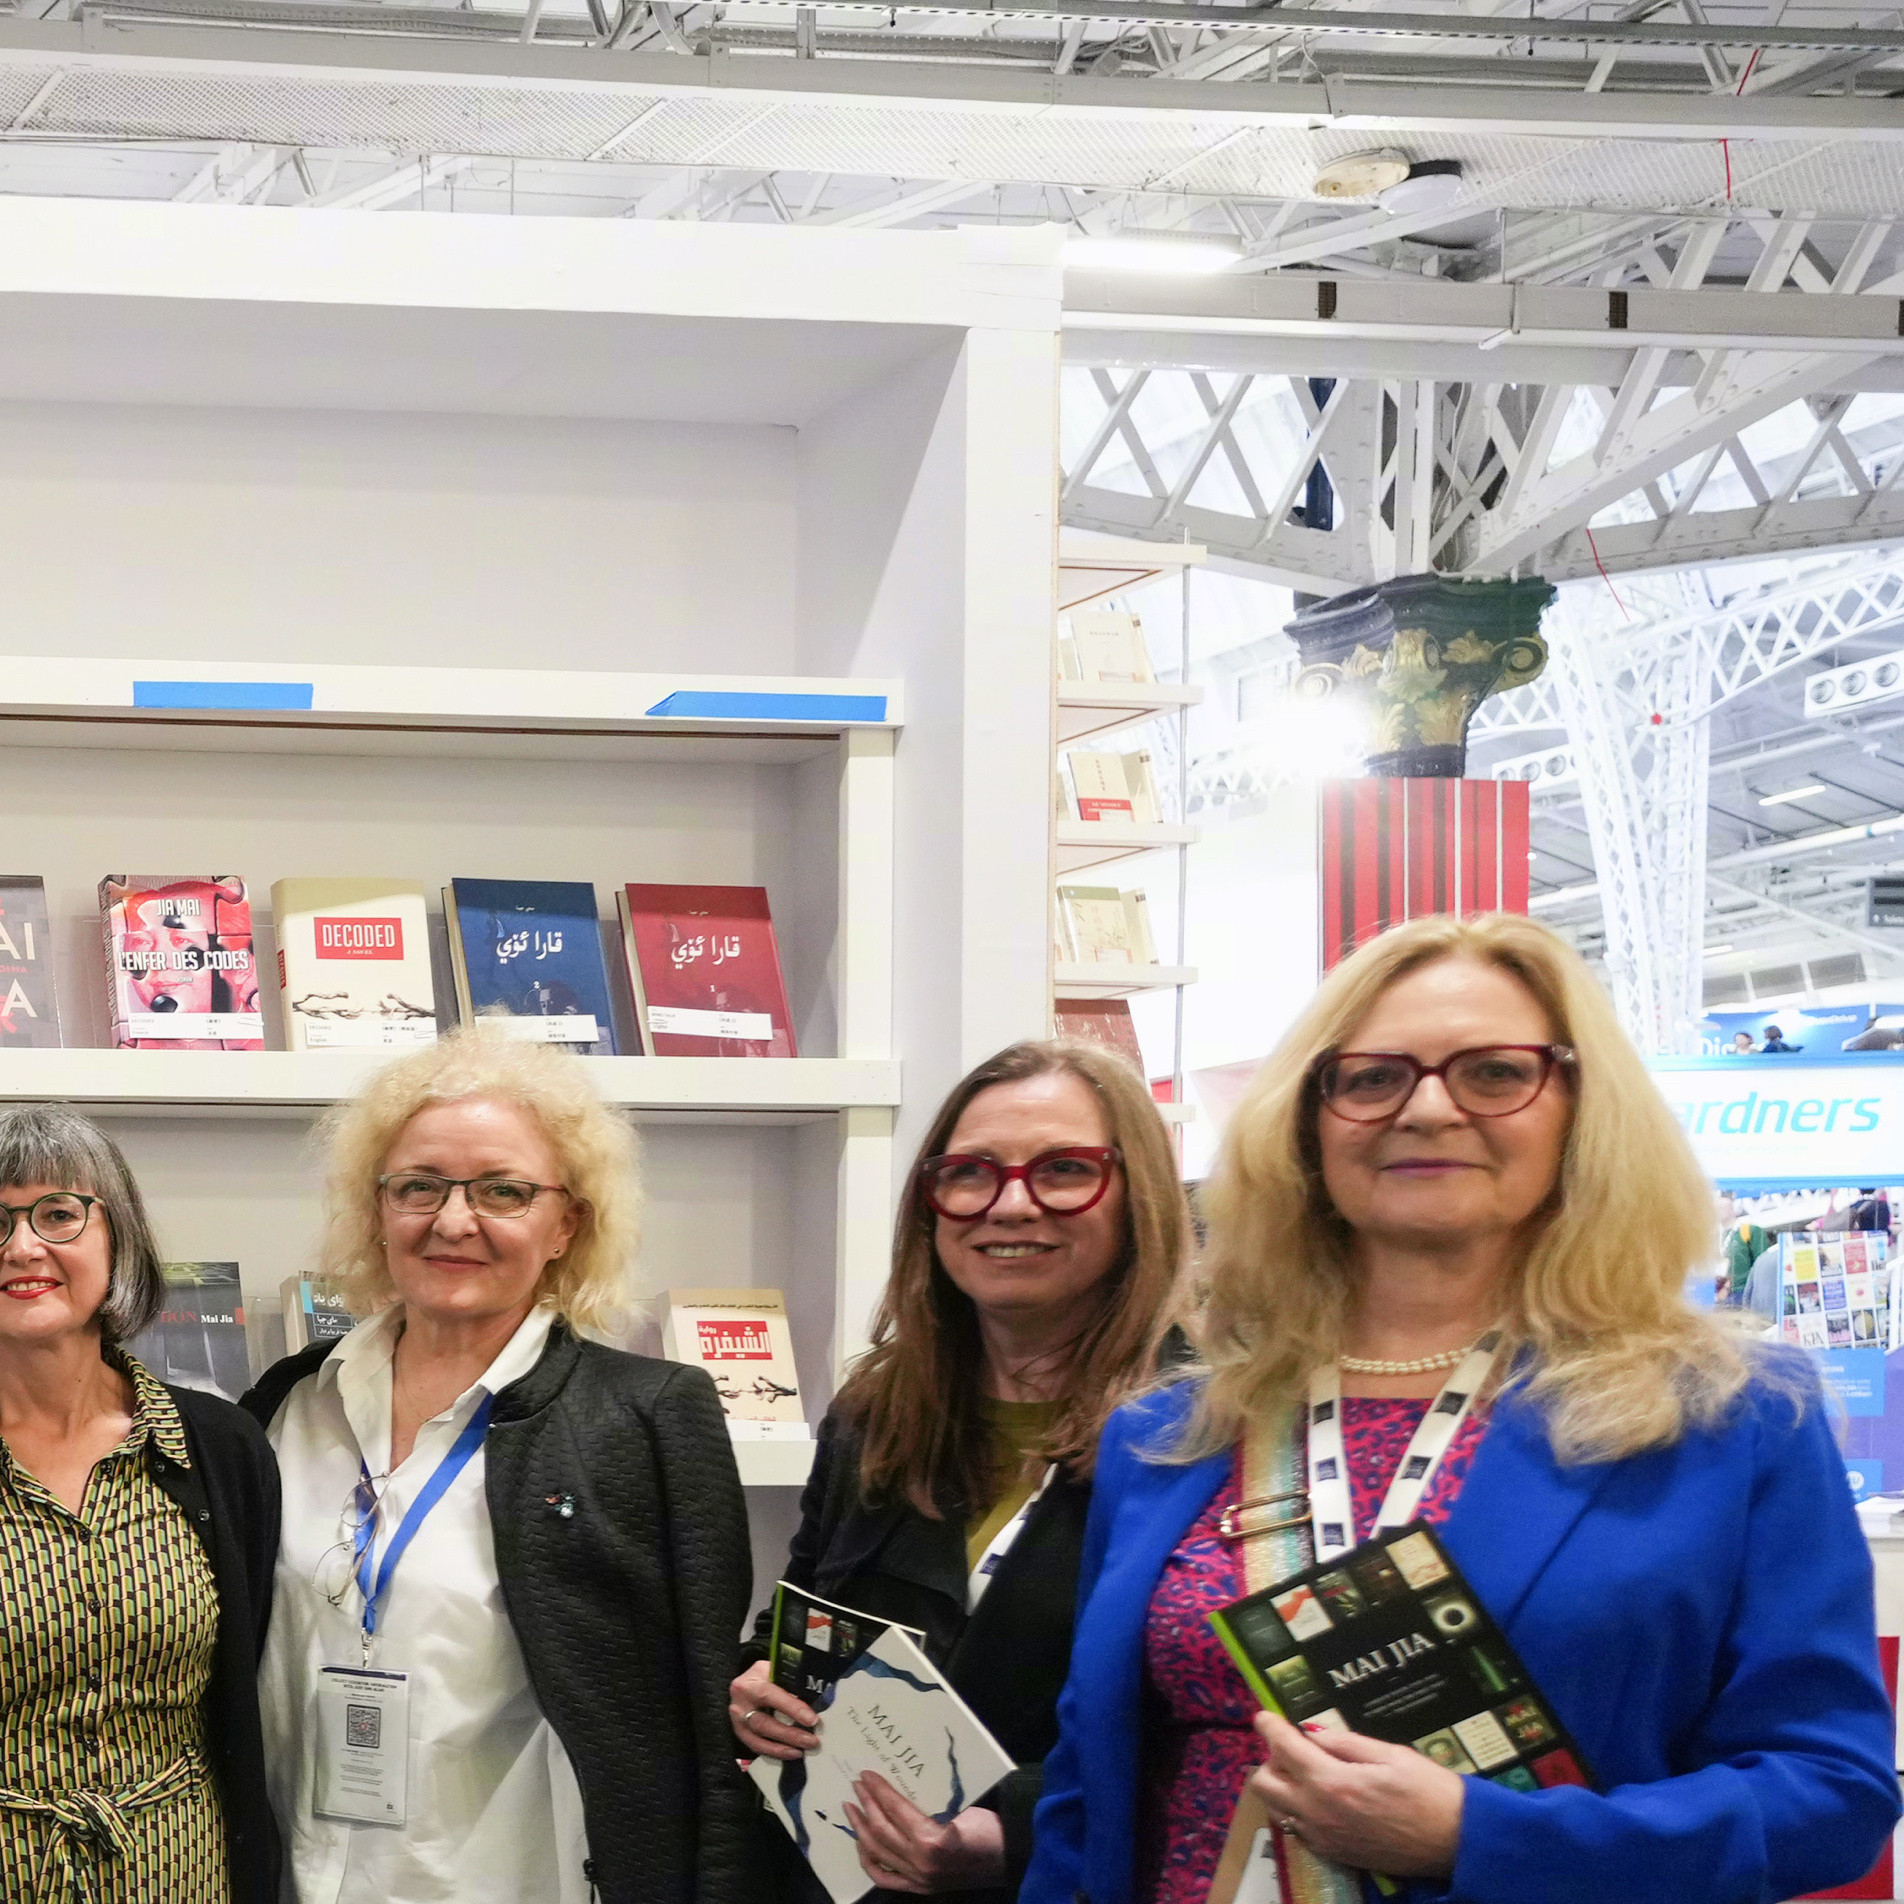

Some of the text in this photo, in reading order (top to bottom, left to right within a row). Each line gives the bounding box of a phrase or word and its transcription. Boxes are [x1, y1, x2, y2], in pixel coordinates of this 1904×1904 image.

[157, 899, 201, 916] JIA MAI
[322, 924, 396, 947] DECODED
[118, 951, 249, 970] L'ENFER DES CODES
[533, 981, 541, 989] 2
[201, 1314, 234, 1323] Mai Jia
[1325, 1631, 1437, 1688] MAI JIA
[867, 1703, 925, 1778] MAI JIA
